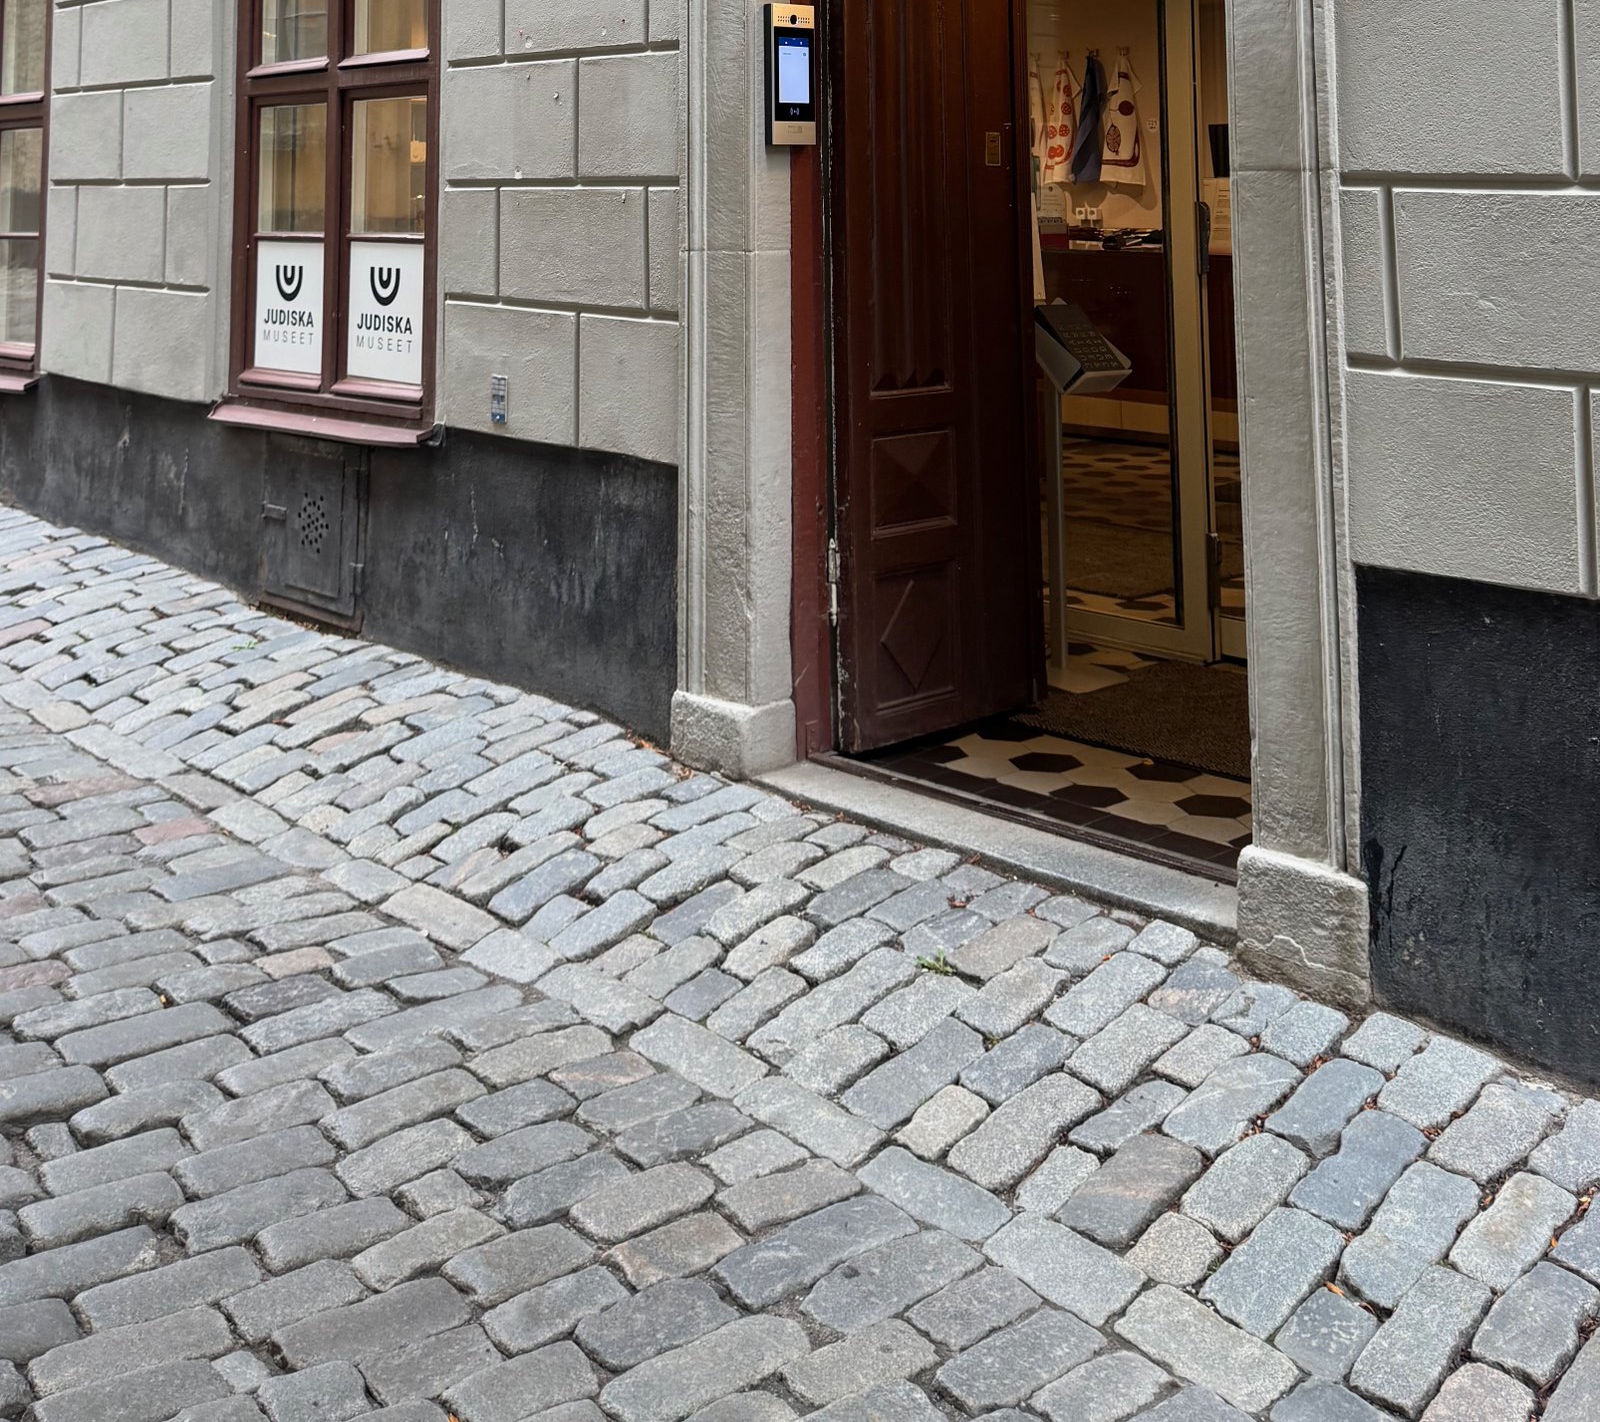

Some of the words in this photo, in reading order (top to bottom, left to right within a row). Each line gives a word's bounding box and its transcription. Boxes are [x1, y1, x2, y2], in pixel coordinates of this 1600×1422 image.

[263, 308, 314, 328] JUDISKA
[356, 313, 413, 335] JUDISKA
[263, 330, 314, 345] MUSEET
[356, 336, 413, 353] MUSEET
